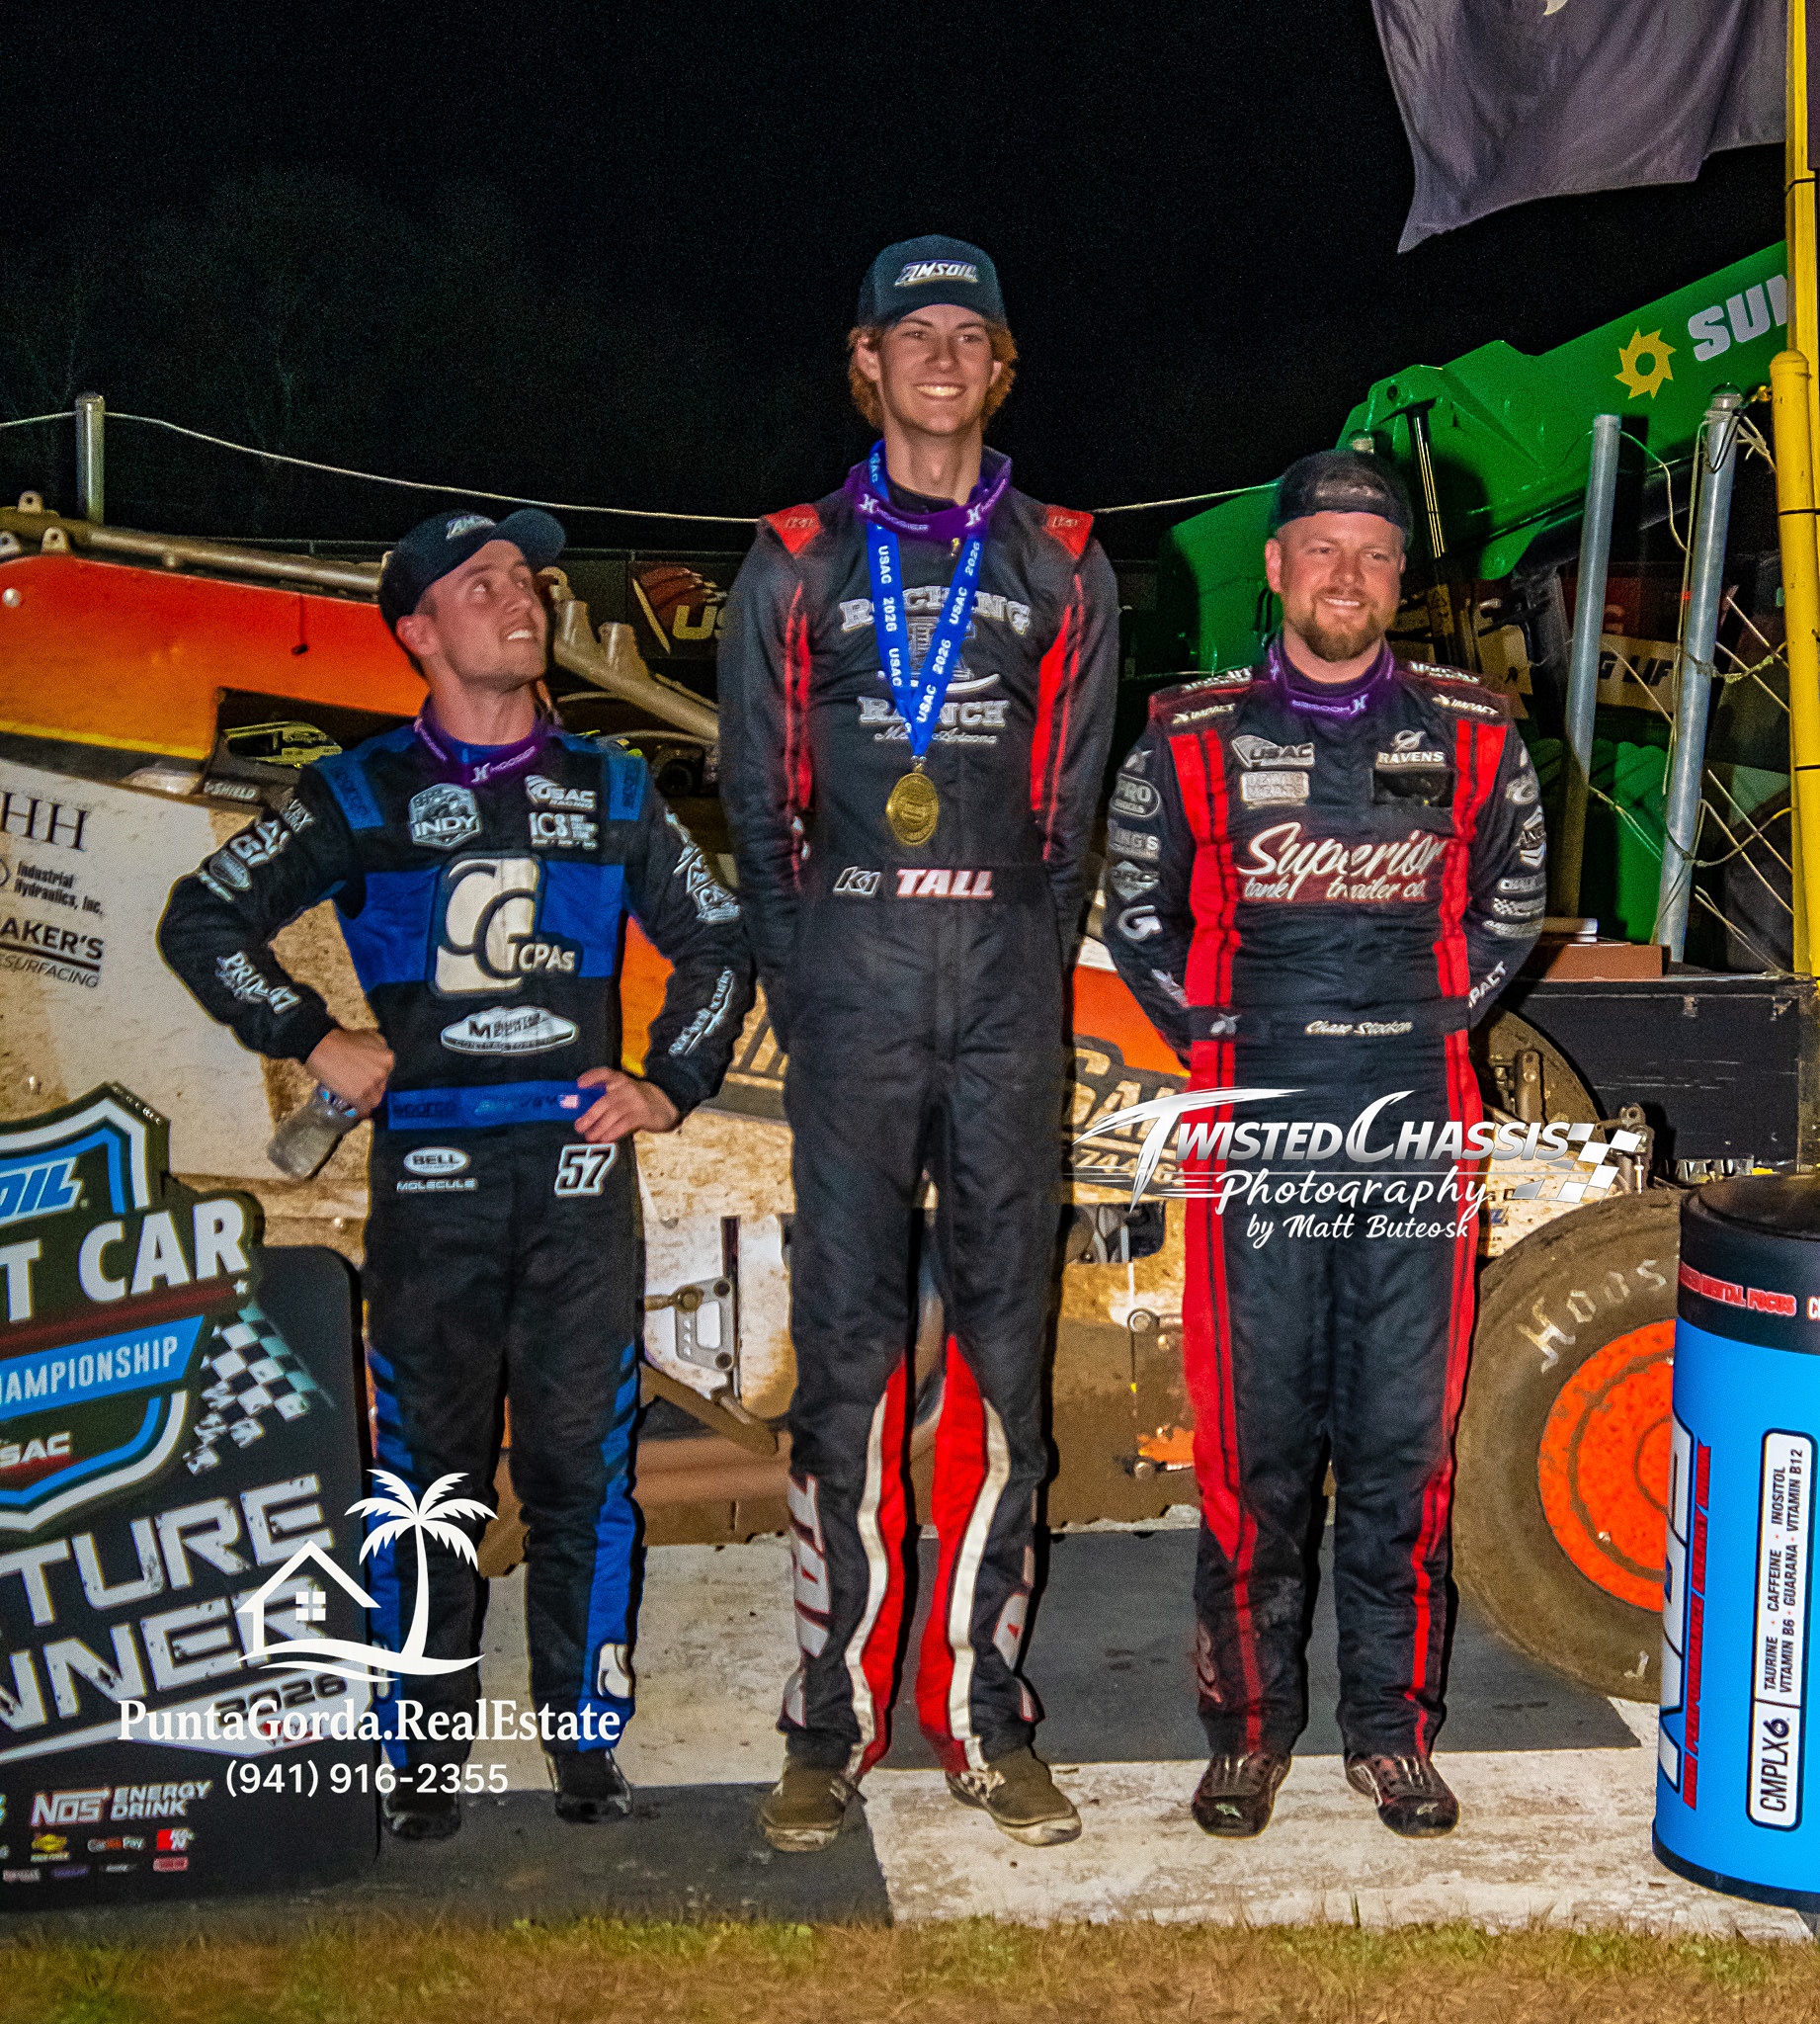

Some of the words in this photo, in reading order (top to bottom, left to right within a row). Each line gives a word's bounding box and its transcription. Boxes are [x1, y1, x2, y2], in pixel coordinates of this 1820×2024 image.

[894, 261, 978, 287] AMSOIL
[877, 545, 893, 585] USAC
[964, 542, 980, 577] 2026
[882, 597, 897, 632] 2026
[949, 587, 968, 625] USAC
[887, 647, 903, 687] USAC
[932, 639, 951, 675] 2026
[916, 684, 938, 723] USAC
[1450, 699, 1500, 717] IMPACT
[1249, 743, 1315, 760] USAC
[1378, 751, 1445, 764] RAVENS
[414, 815, 477, 837] INDY
[17, 861, 75, 889] Industrial
[1237, 821, 1448, 900] Superior
[895, 868, 994, 898] TALL
[1244, 877, 1290, 898] tank
[82, 894, 103, 916] Inc.
[0, 955, 100, 988] SURFACING
[519, 942, 575, 971] CPAs
[1468, 961, 1509, 1007] PACT
[412, 1154, 460, 1165] BELL
[552, 1144, 616, 1197] 57
[396, 1180, 475, 1191] MOLECULE
[78, 1198, 250, 1304] CAR
[1747, 1288, 1797, 1317] FOCUS
[1789, 1448, 1803, 1476] B12
[1771, 1466, 1786, 1526] INOSITOL
[1786, 1478, 1802, 1533] VITAMIN
[0, 1474, 334, 1626] TURE
[1767, 1549, 1782, 1613] CAFFEINE
[1782, 1544, 1799, 1607] GUARANA
[1782, 1618, 1795, 1637] B6
[1764, 1636, 1779, 1691] TAURINE
[1779, 1639, 1795, 1694] VITAMIN
[31, 1788, 111, 1827] NOS
[110, 1799, 186, 1820] DRINK
[113, 1780, 212, 1805] ENERGY
